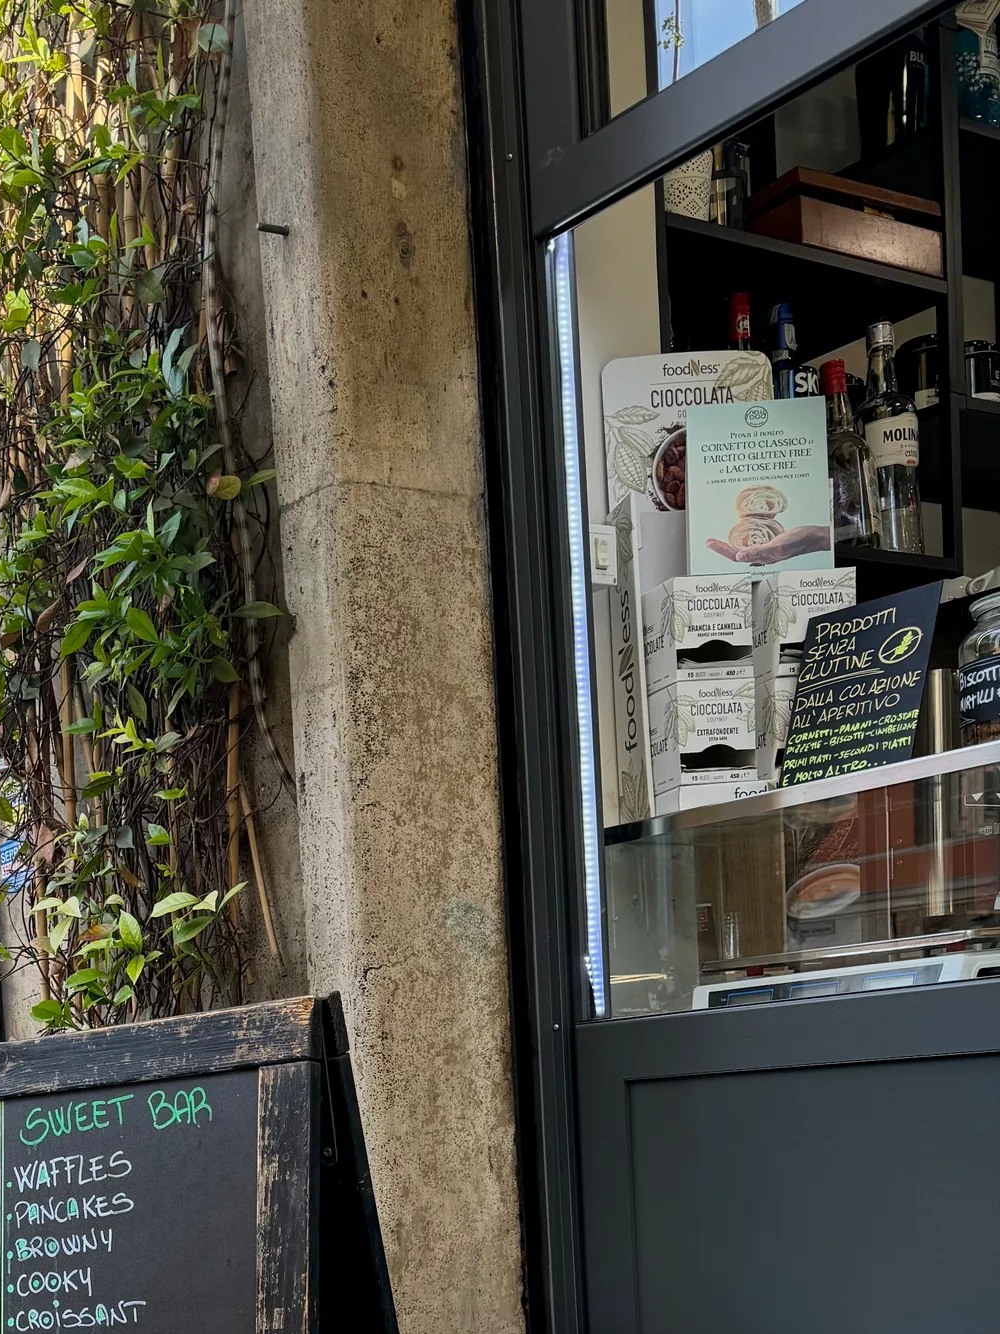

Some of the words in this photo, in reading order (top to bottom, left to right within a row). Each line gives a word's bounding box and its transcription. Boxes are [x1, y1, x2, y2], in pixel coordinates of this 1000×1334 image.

[650, 386, 735, 409] CIOCCOLATA
[701, 441, 756, 452] CORNETTO
[758, 437, 807, 449] CLASSICO
[730, 431, 751, 440] Prova
[703, 453, 746, 464] FARCITO
[748, 450, 787, 461] GLUTEN
[789, 448, 812, 458] FREE
[726, 462, 771, 474] LACTOSE
[773, 460, 796, 470] FREE
[687, 598, 740, 612] CIOCCOLATA
[791, 592, 844, 606] CIOCCOLATA
[687, 623, 711, 633] ARANCIA
[717, 622, 742, 631] CANNELLA
[815, 607, 897, 643] PRODOTTI
[805, 636, 857, 663] SENZA
[798, 649, 875, 683] GLUTINE
[794, 690, 833, 712] DALLA
[840, 670, 922, 701] COLAZIONE
[690, 702, 743, 716] CIOCCOLATA
[697, 727, 739, 737] EXTRAFONDENTE
[882, 736, 911, 750] PIATTI
[794, 769, 823, 783] MOLTO
[19, 1093, 134, 1146] SWEET
[147, 1086, 212, 1130] BAR
[13, 1150, 133, 1194] WAFFLES
[14, 1193, 135, 1229] PANCAKES
[15, 1228, 113, 1261] BROWNY
[16, 1267, 93, 1297] COOKY
[15, 1300, 147, 1332] CROISSANT
